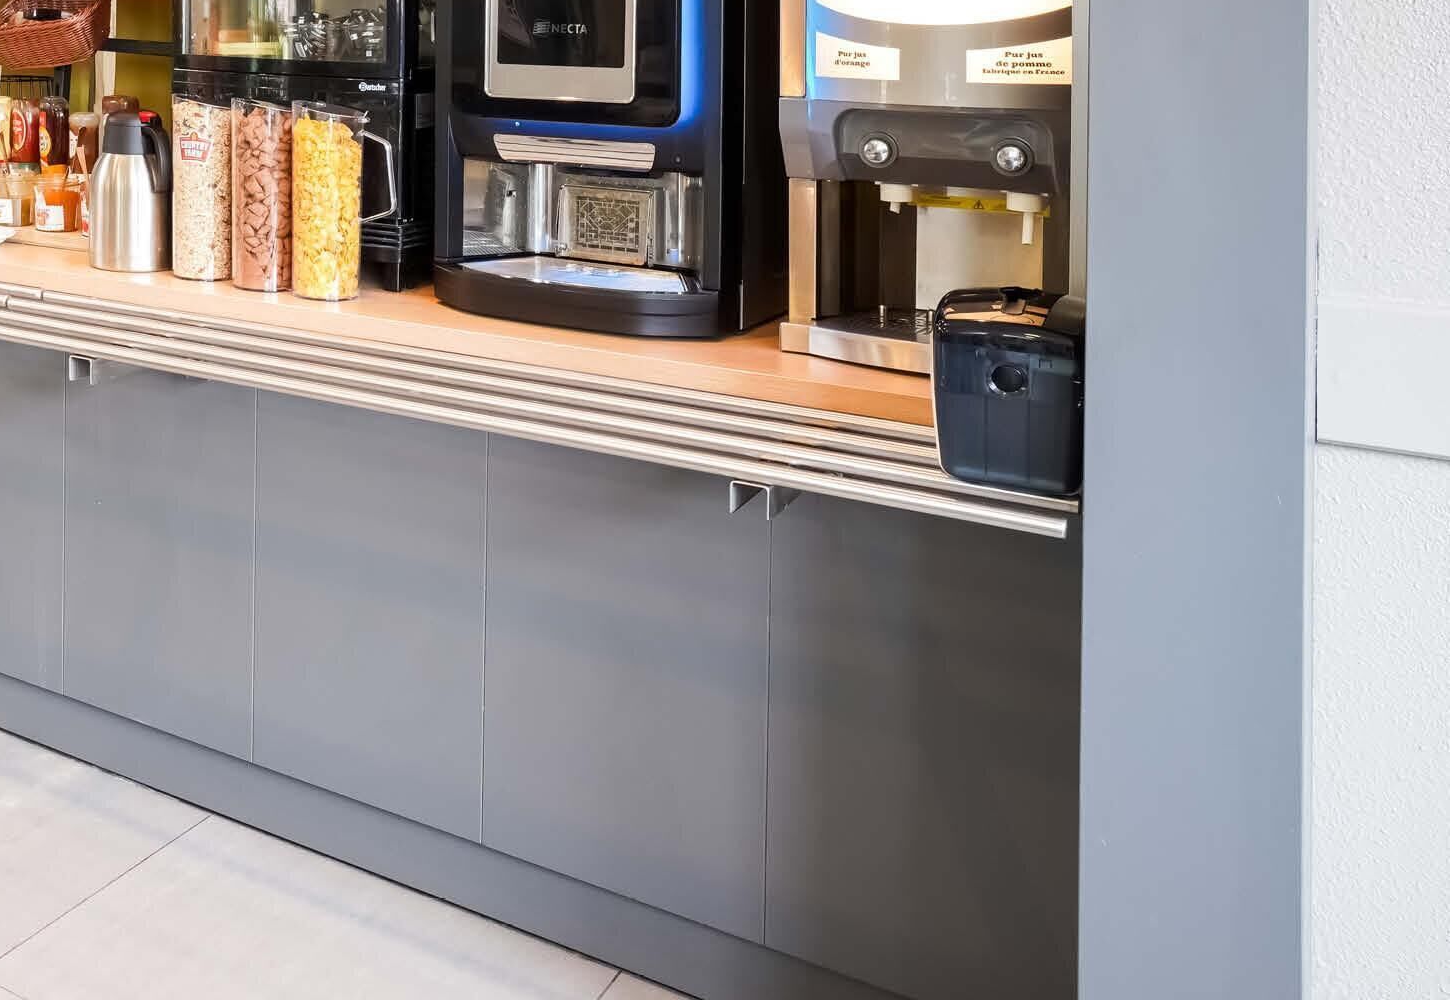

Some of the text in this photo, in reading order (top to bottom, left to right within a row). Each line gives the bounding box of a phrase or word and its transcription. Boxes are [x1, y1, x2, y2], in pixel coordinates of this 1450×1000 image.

[551, 23, 588, 35] NECTA
[854, 50, 867, 59] jus
[1026, 51, 1043, 59] jus
[834, 59, 871, 68] d'orange
